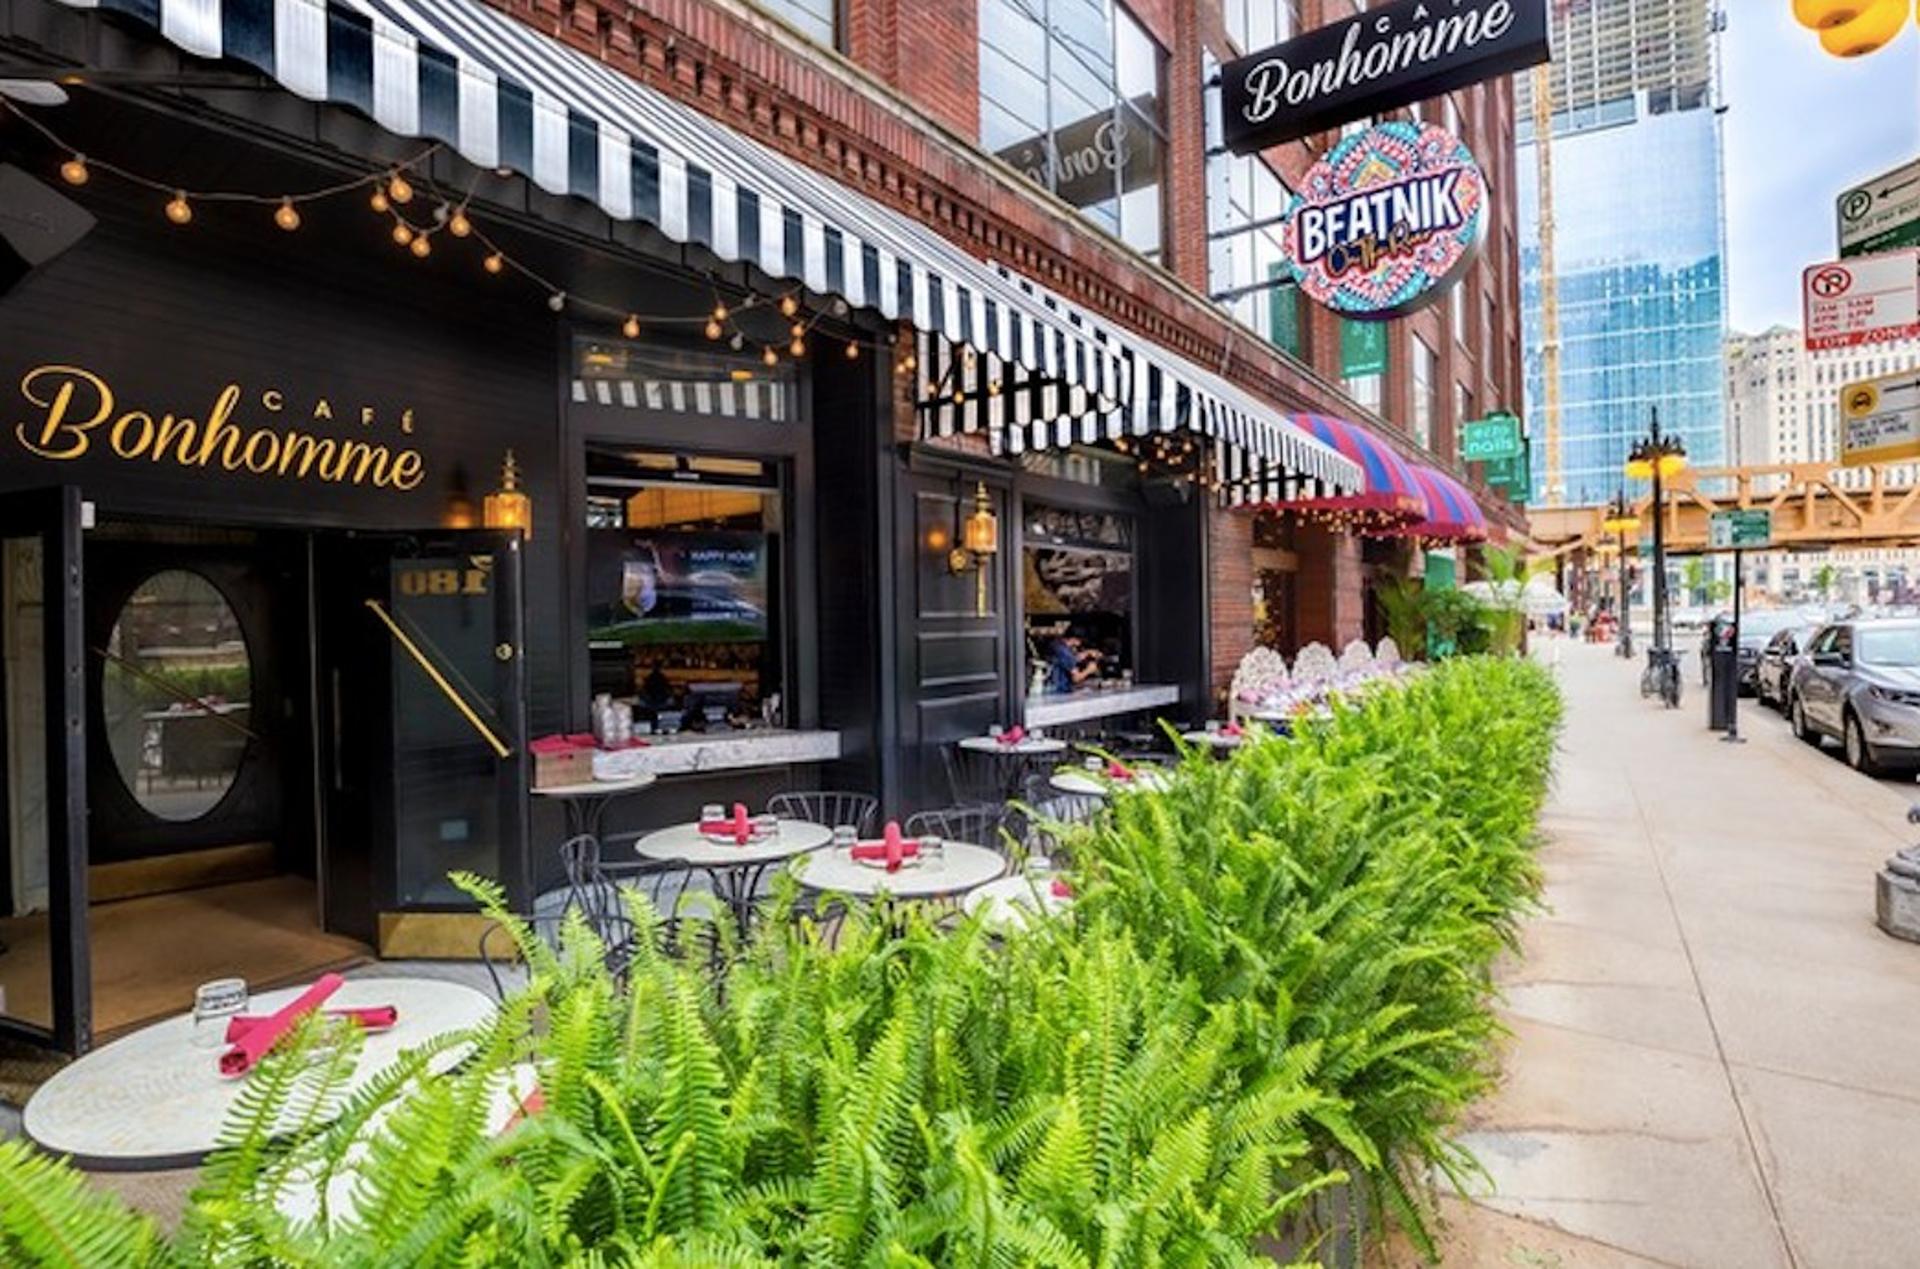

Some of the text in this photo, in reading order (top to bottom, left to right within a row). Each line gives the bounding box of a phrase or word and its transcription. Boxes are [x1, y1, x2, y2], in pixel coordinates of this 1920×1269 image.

[1242, 0, 1515, 124] Bonhomme
[1302, 173, 1462, 262] BEATNIK
[1814, 326, 1910, 348] TOW ZONE
[15, 363, 426, 492] Bonhomme
[262, 389, 417, 434] CAFÉ
